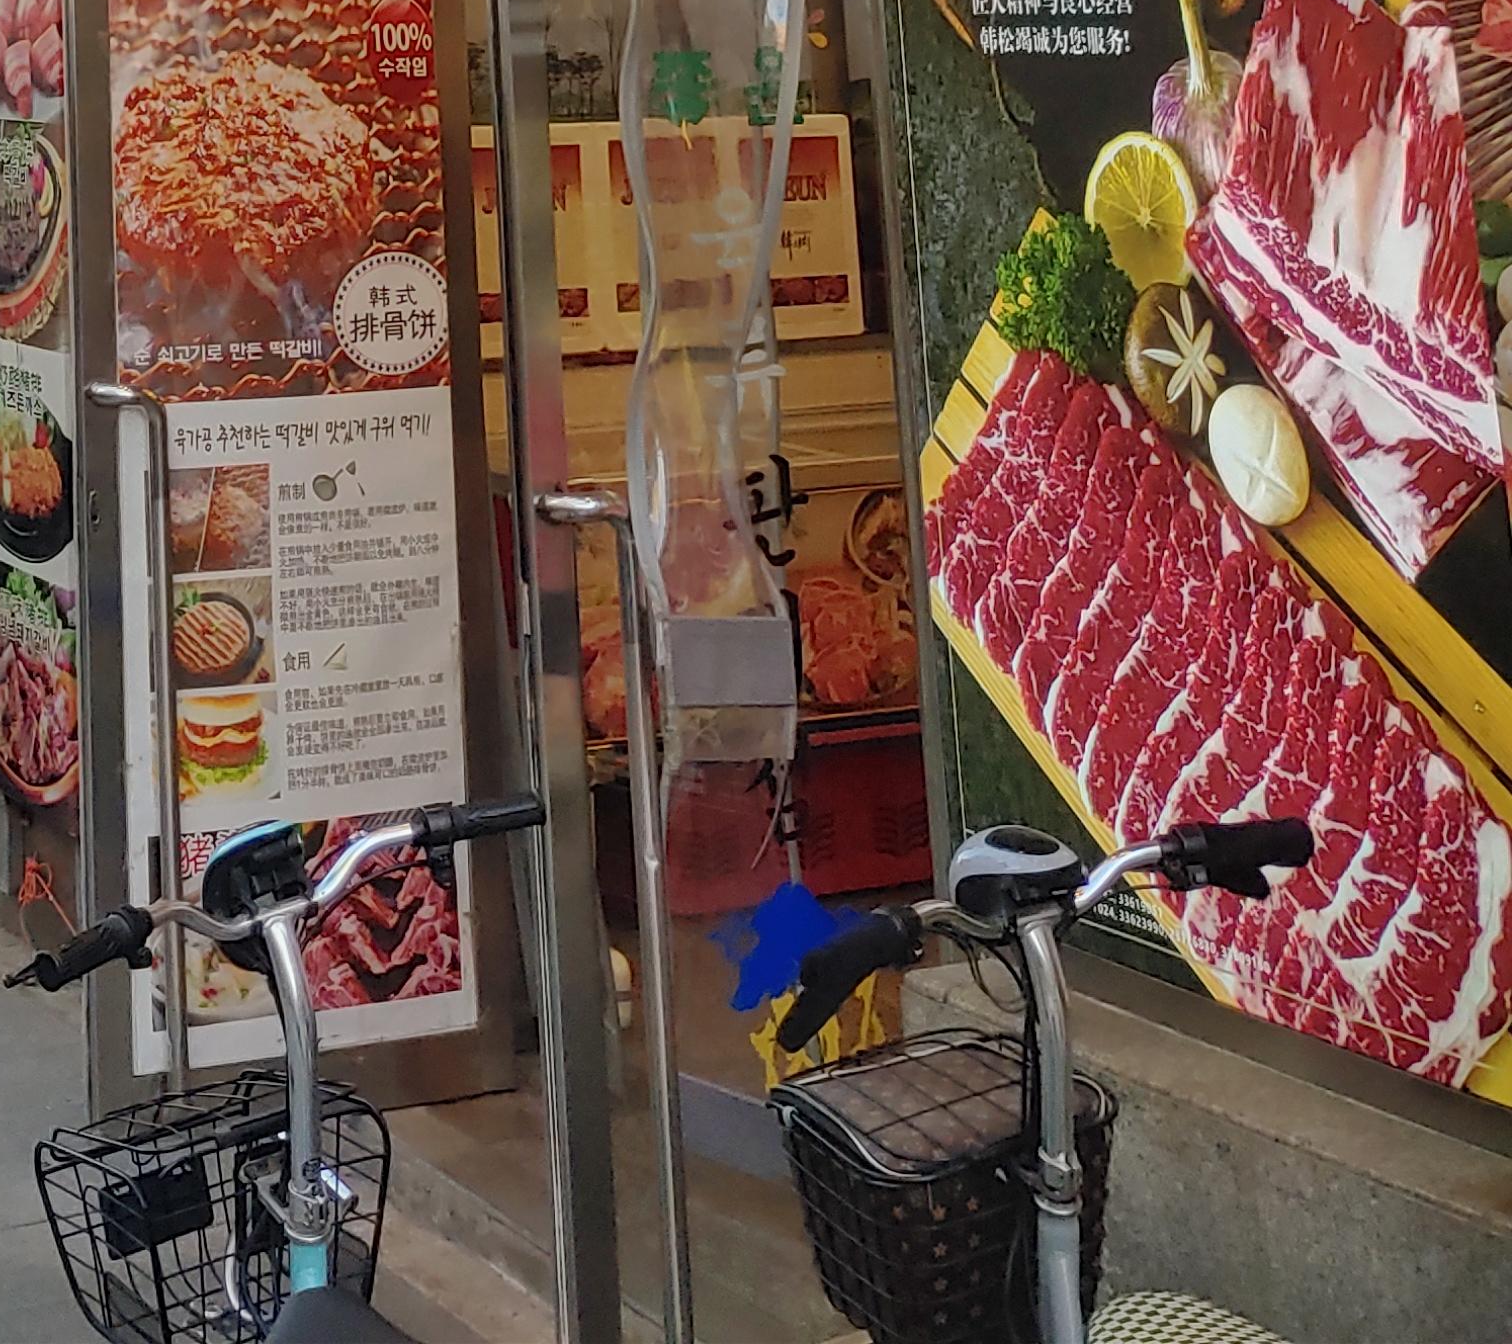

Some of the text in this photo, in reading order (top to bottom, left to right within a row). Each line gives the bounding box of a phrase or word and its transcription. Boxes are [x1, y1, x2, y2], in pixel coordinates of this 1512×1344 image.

[370, 22, 432, 53] 100%
[378, 57, 428, 79] 수작업
[369, 284, 418, 308] 韩式
[350, 309, 437, 344] 排骨饼
[158, 342, 224, 364] 쇠고기로
[229, 341, 264, 362] 만든
[174, 427, 212, 455] 육가공
[216, 423, 270, 453] 추천하는
[275, 422, 319, 448] 떡갈비
[282, 651, 312, 672] 食用
